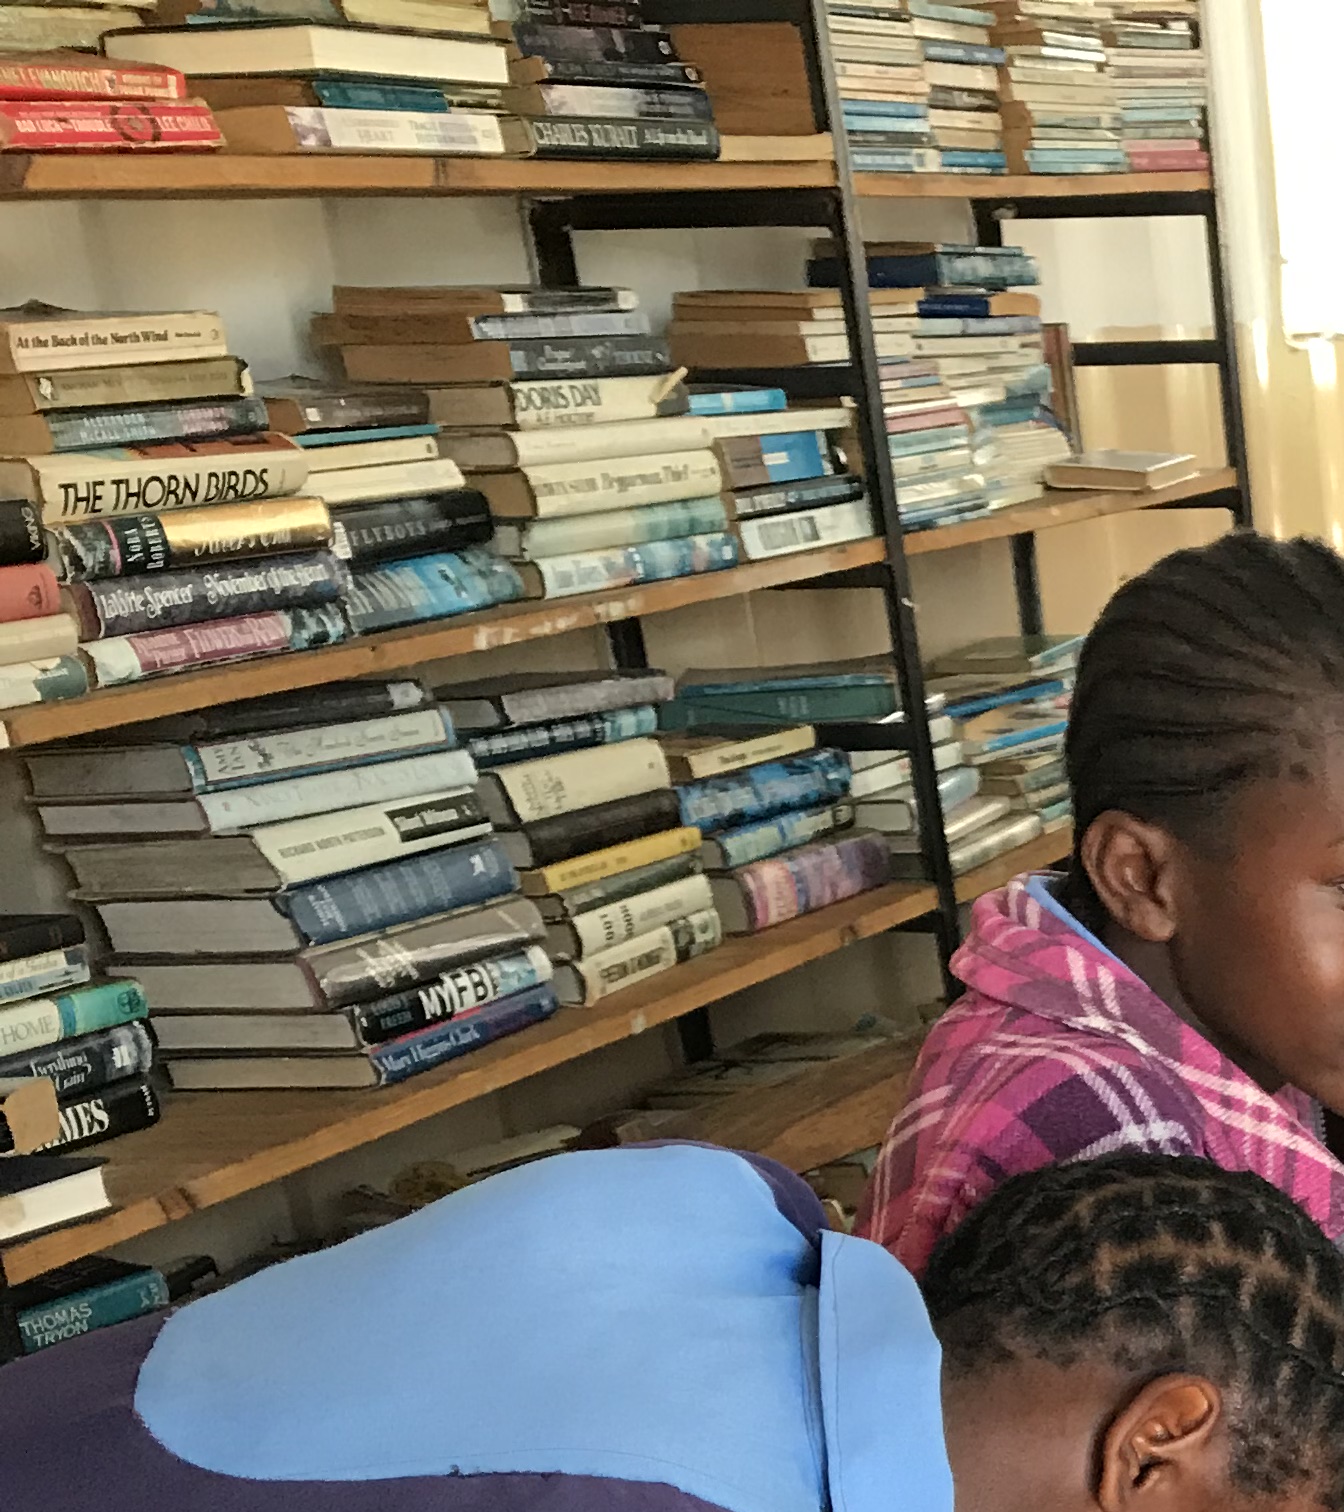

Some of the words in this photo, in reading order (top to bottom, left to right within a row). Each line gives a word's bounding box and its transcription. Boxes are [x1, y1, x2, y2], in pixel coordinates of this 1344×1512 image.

[16, 336, 30, 350] At
[31, 335, 50, 348] the
[51, 334, 78, 349] Back
[90, 333, 108, 347] the
[110, 332, 140, 345] North
[140, 330, 169, 343] Wind
[514, 383, 570, 412] DORIS
[58, 479, 106, 516] THE
[111, 472, 201, 511] THORN
[202, 468, 269, 502] BIRDS
[20, 505, 43, 551] VIKING
[146, 583, 193, 618] Spencer
[1, 1015, 56, 1045] HOME
[19, 1302, 93, 1337] THOMAS
[33, 1319, 90, 1347] TRYON
